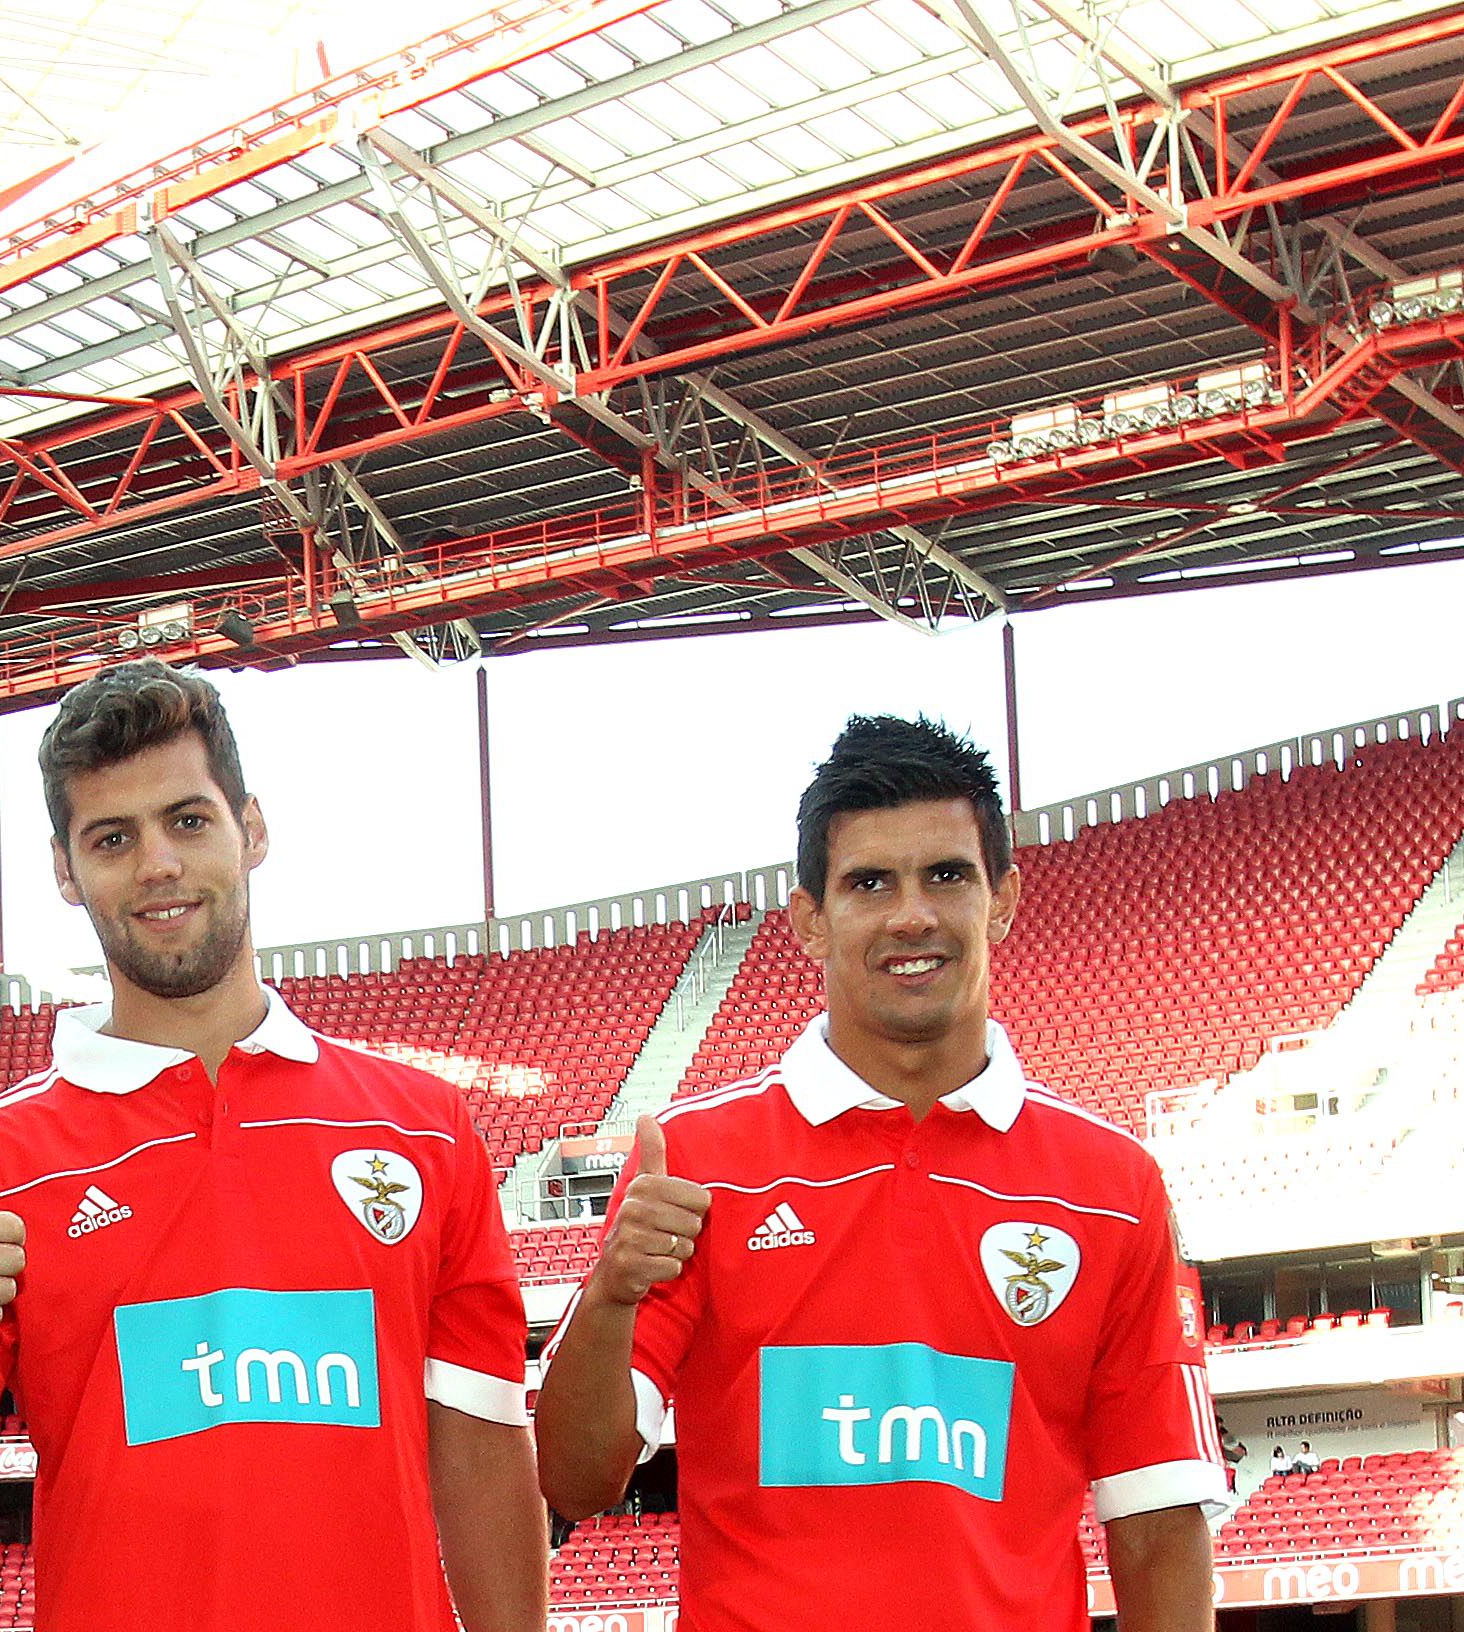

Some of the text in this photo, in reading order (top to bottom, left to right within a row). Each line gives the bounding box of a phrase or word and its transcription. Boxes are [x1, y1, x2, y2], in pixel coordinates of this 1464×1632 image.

[585, 1152, 625, 1170] meo
[67, 1204, 133, 1238] adidas
[747, 1229, 815, 1251] adidas
[181, 1341, 361, 1408] tmn
[1266, 1409, 1363, 1427] ALTA DEFINIÇÃO
[822, 1394, 986, 1479] tmn
[1264, 1563, 1359, 1600] meo
